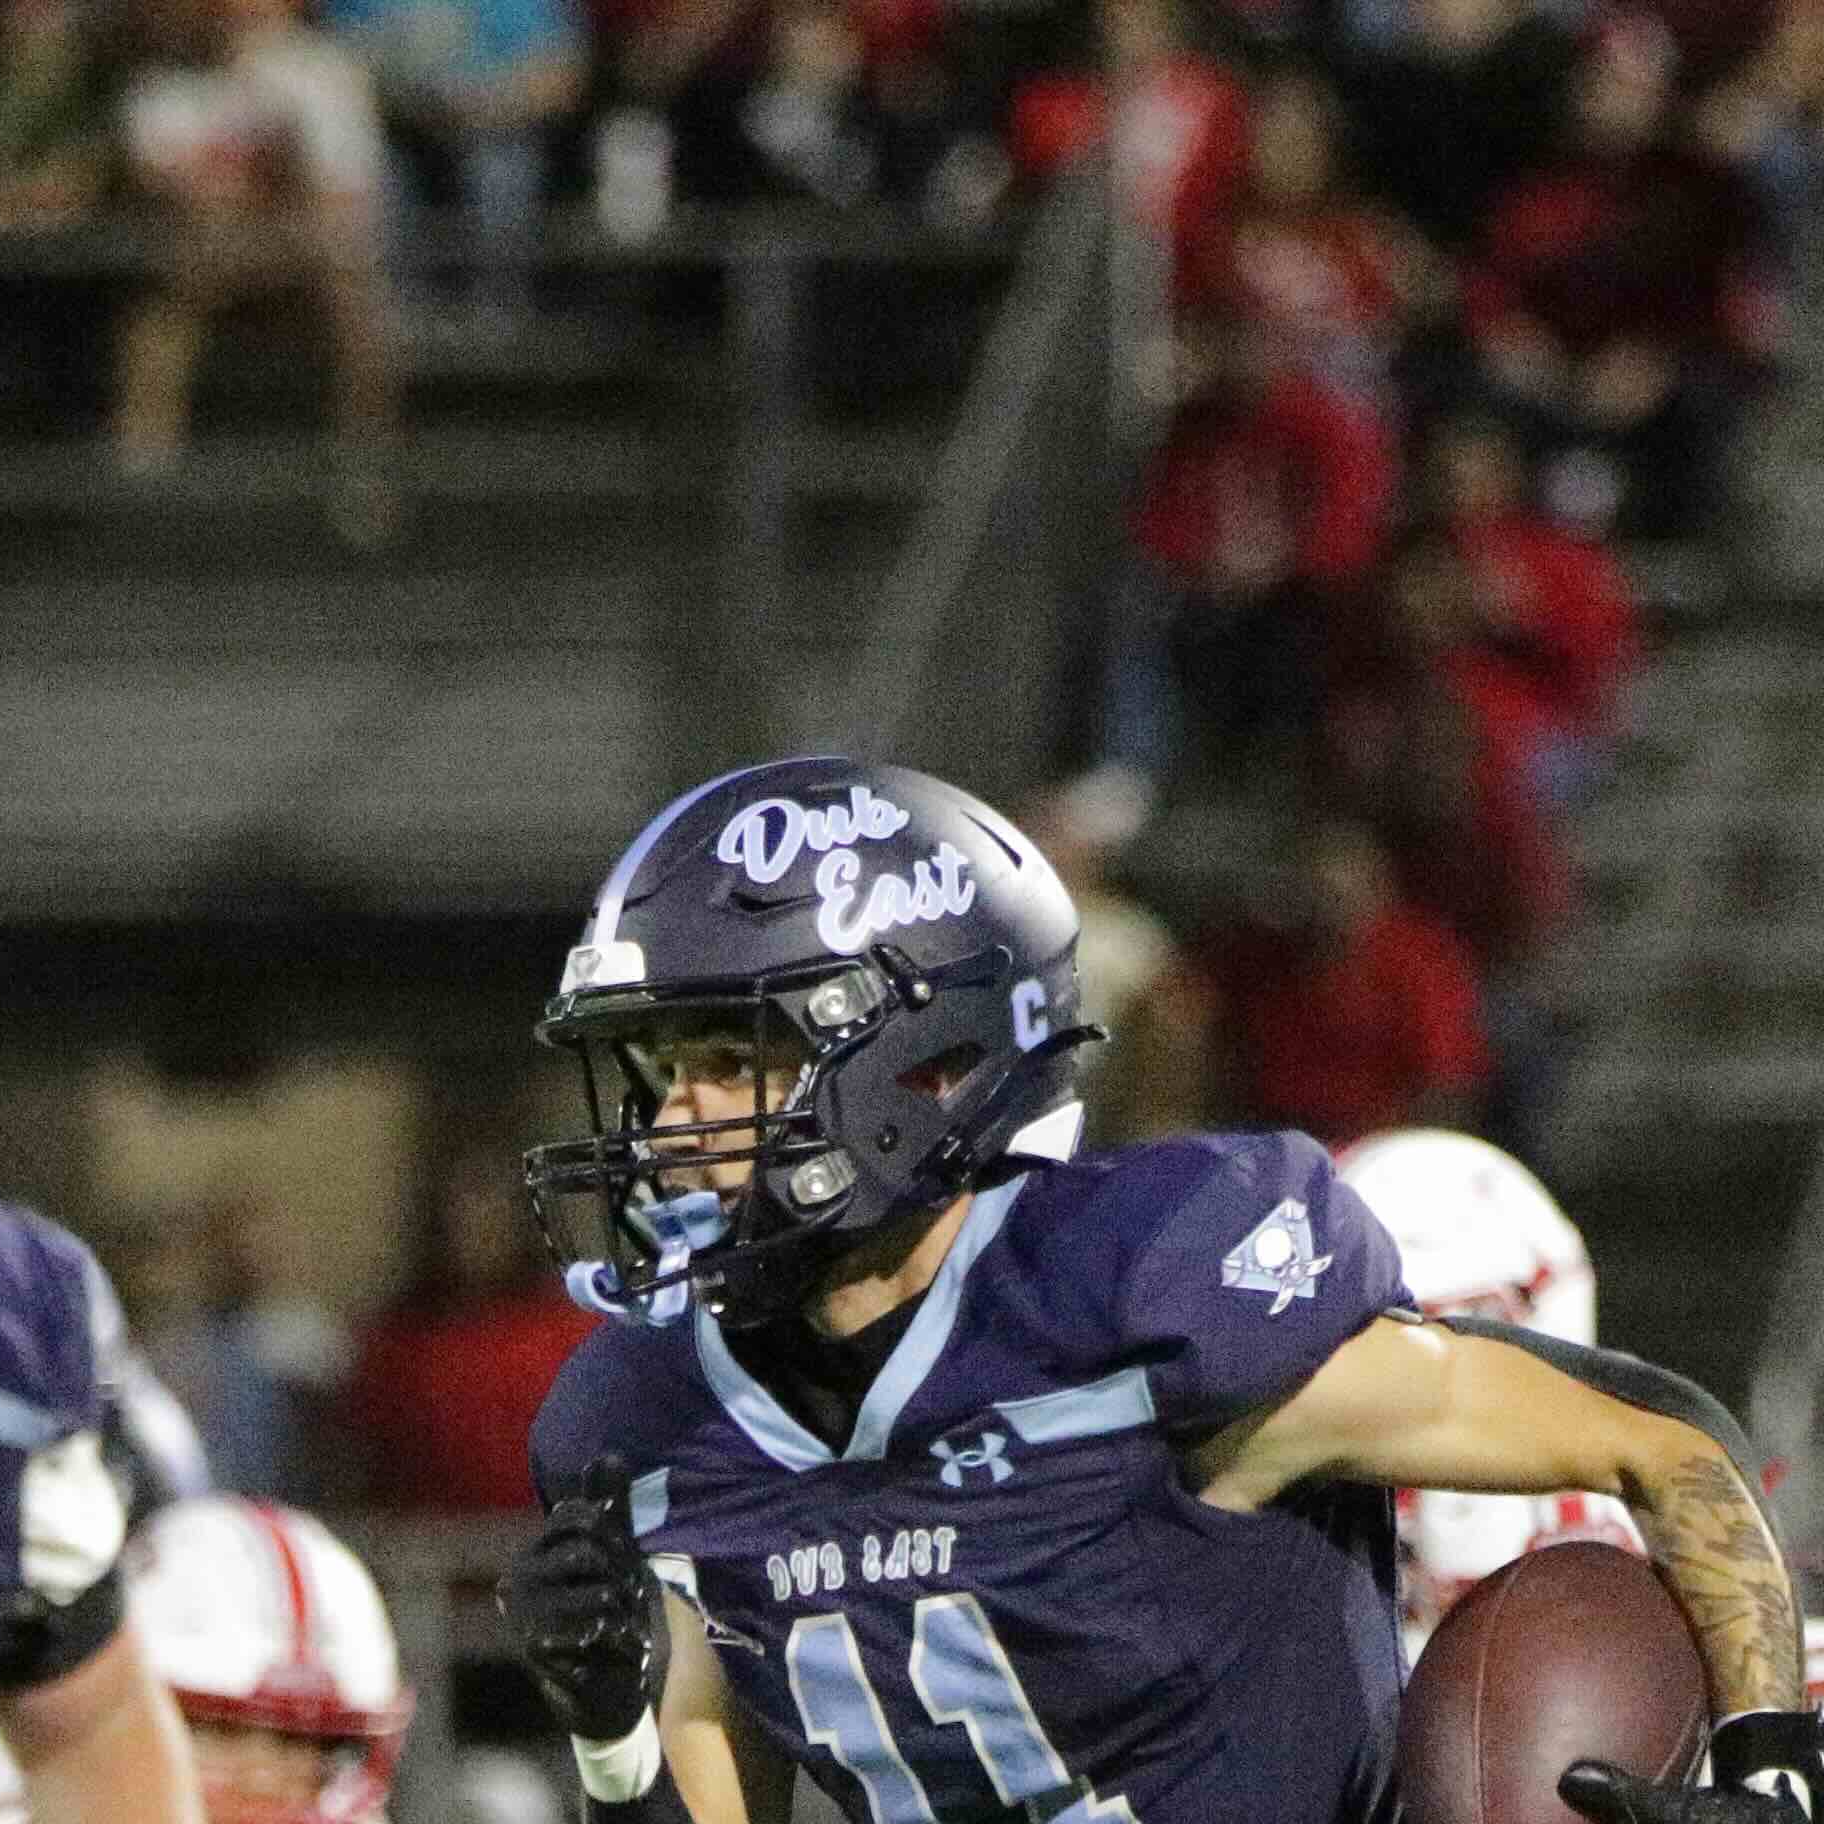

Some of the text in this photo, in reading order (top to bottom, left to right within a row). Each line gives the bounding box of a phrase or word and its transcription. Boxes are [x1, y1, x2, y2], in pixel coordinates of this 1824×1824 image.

[716, 786, 909, 884] Dub
[814, 842, 975, 956] East
[1012, 980, 1049, 1052] C
[766, 1526, 957, 1602] DUB EAST
